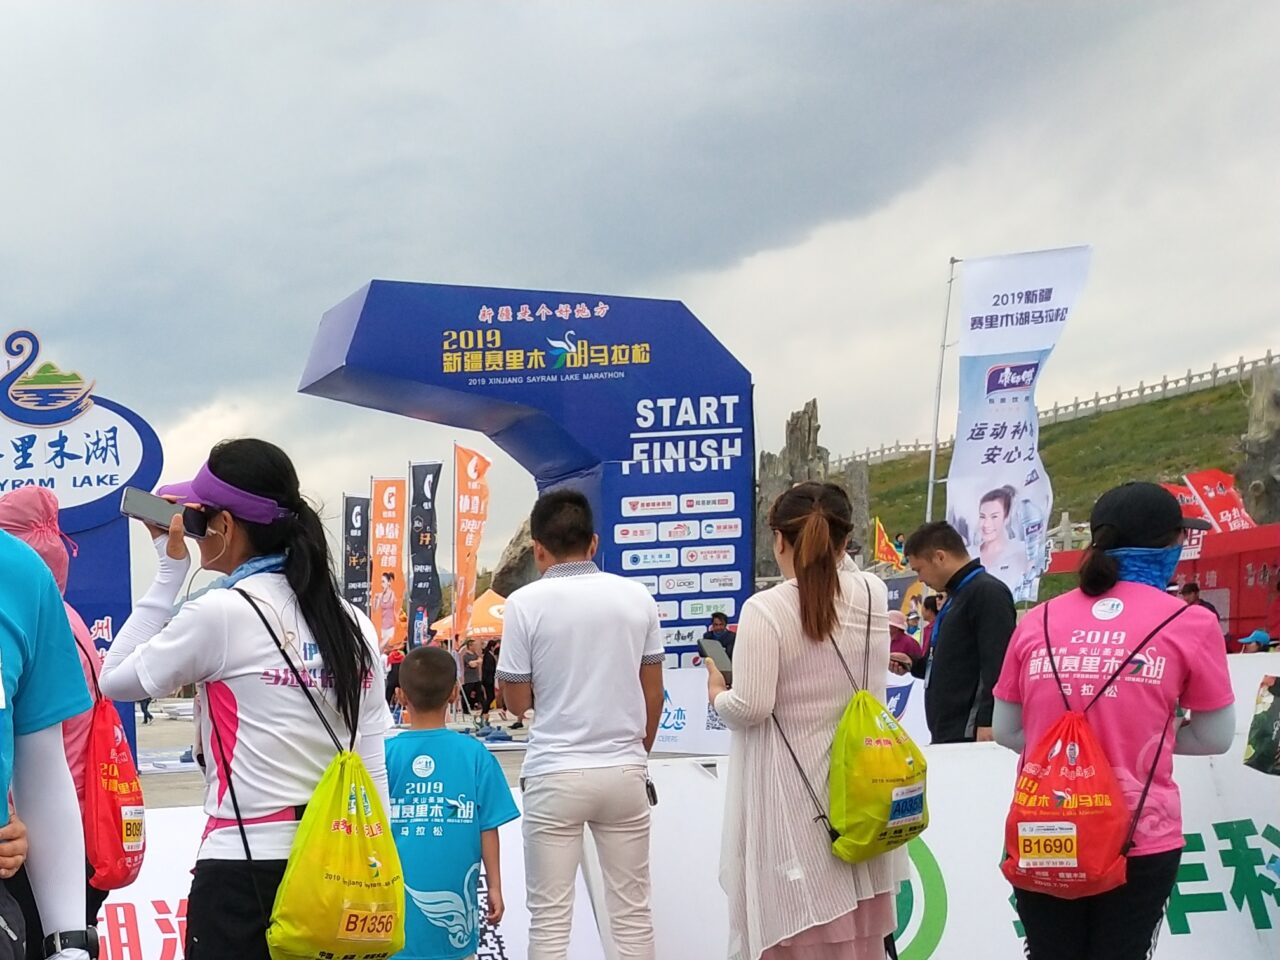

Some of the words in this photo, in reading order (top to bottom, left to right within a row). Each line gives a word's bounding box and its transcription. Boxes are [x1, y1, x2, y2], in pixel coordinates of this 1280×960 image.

[992, 288, 1053, 306] 2019新疆
[478, 302, 610, 324] 新疆是个好地方
[970, 307, 1068, 330] 赛里木湖马拉松
[442, 329, 501, 350] 2019
[468, 378, 486, 386] 2019
[488, 376, 524, 385] XINJIANG
[526, 375, 558, 384] SAYRAM
[560, 373, 580, 382] LAKE
[582, 371, 625, 381] MARATHON
[636, 395, 739, 428] START
[622, 438, 741, 475] FINISH
[72, 473, 120, 488] LAKE
[1071, 630, 1127, 645] 2019
[1060, 683, 1118, 698] 马拉松
[405, 782, 443, 794] 2019
[1022, 838, 1074, 854] B1690
[345, 913, 393, 935] B1356
